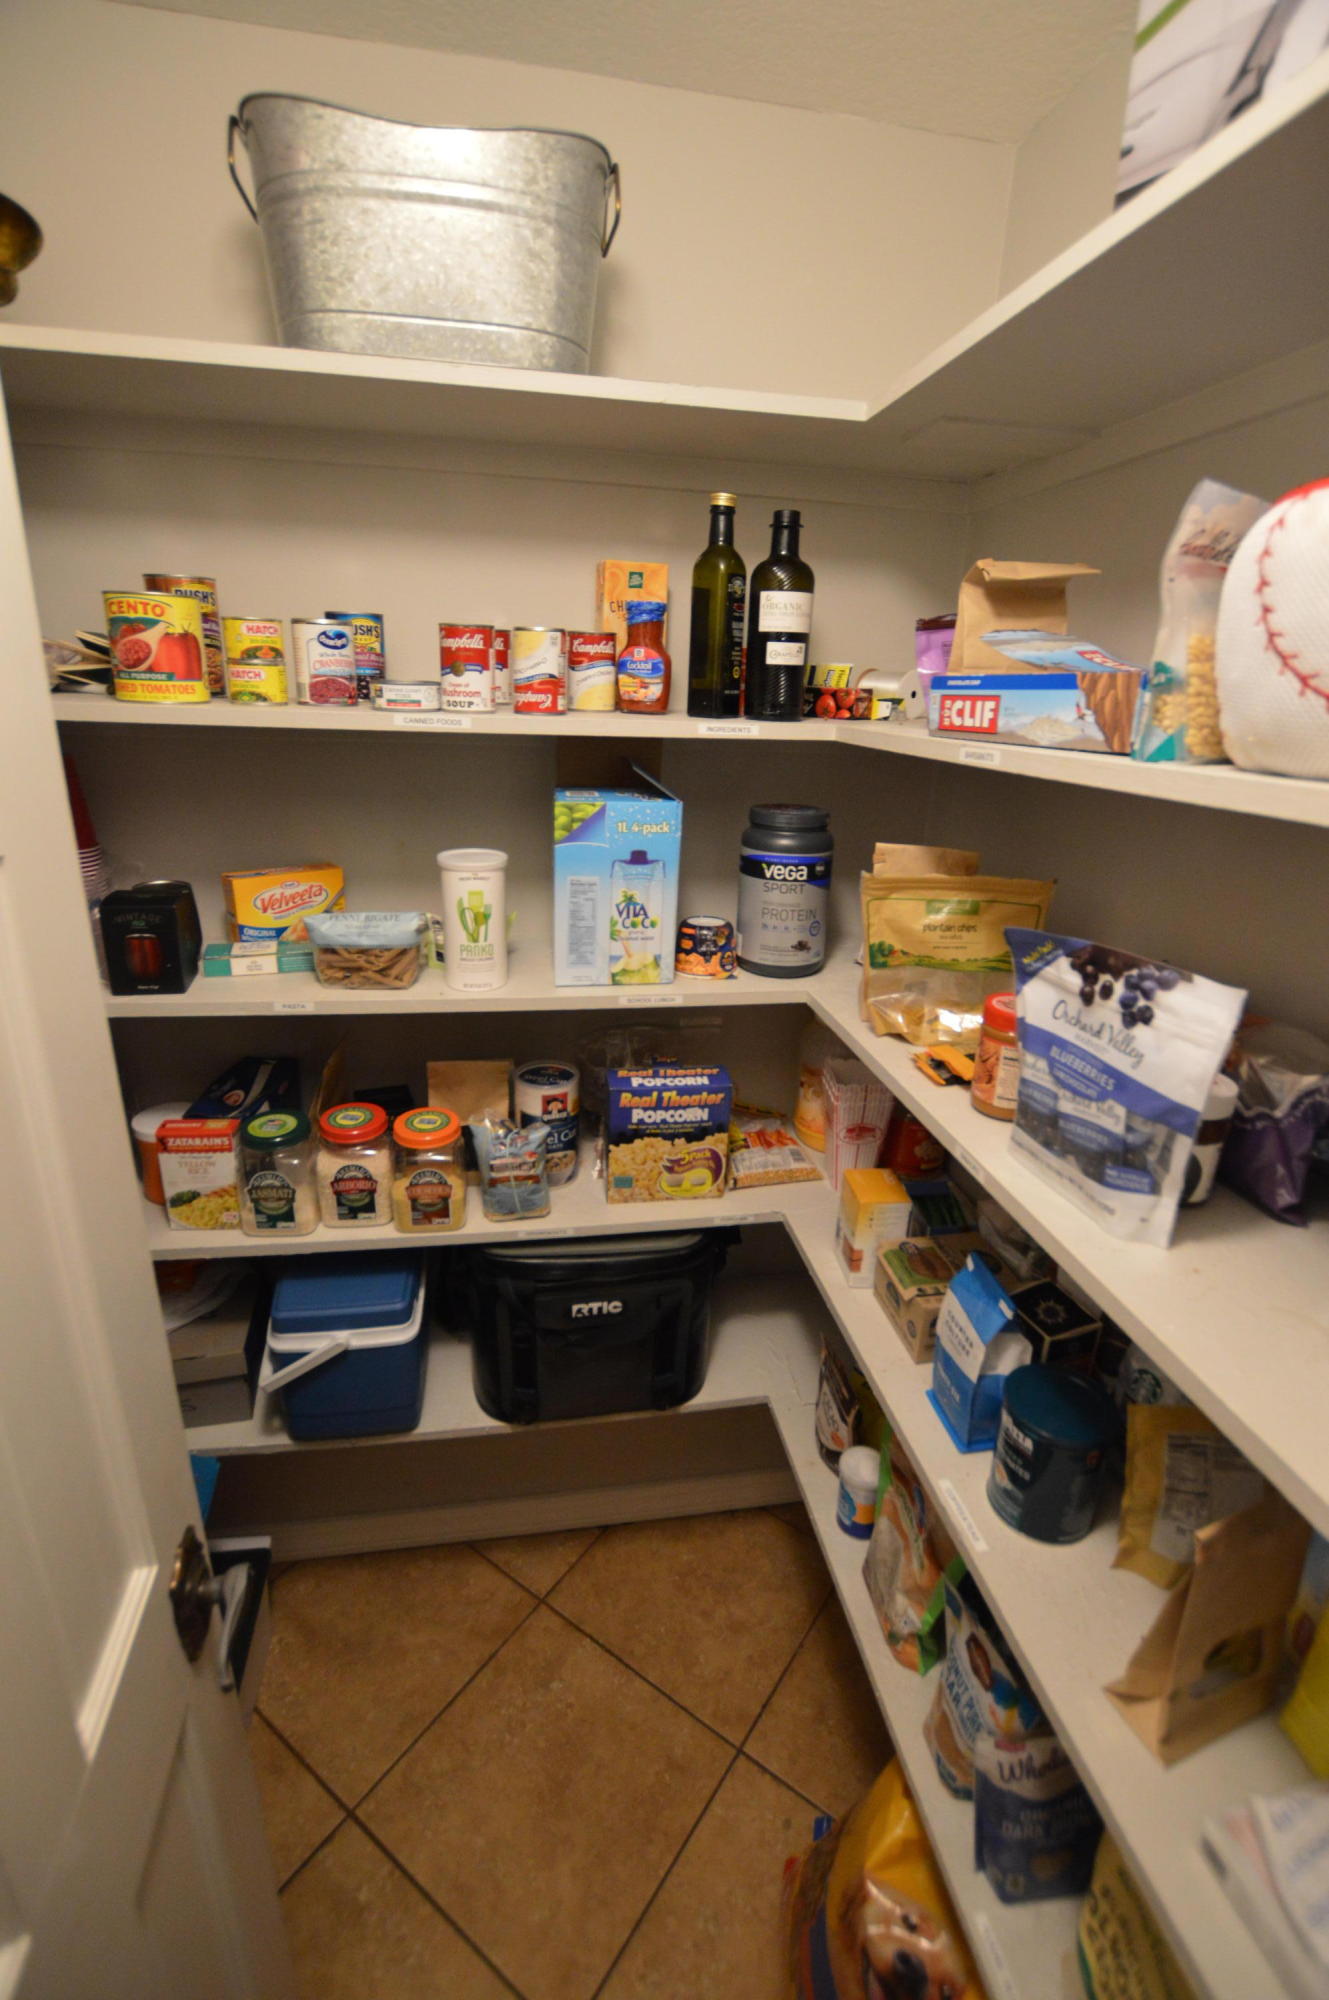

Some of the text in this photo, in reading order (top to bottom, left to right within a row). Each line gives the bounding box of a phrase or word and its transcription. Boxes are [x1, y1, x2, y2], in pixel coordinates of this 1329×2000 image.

[107, 600, 165, 617] CENTO
[141, 683, 197, 695] TOMATOES
[446, 700, 475, 709] SOUP
[951, 700, 997, 728] CLIF
[403, 717, 463, 726] CANNED FOODS
[616, 821, 670, 835] 1L 4-pack
[763, 882, 806, 895] SPORT
[260, 883, 323, 914] Velveeta
[615, 902, 649, 919] VITA
[761, 907, 817, 921] PROTEIN
[460, 944, 495, 958] PANKO
[1052, 999, 1147, 1071] Orchard Valley
[617, 1067, 721, 1078] Real Theater
[1050, 1045, 1118, 1092] BLUEBERRIES
[630, 1075, 710, 1087] POPCORN
[619, 1090, 726, 1108] Real Theater
[631, 1107, 710, 1124] POPCORN
[167, 1137, 230, 1147] ZATARAIN'S
[572, 1300, 623, 1318] RTIC
